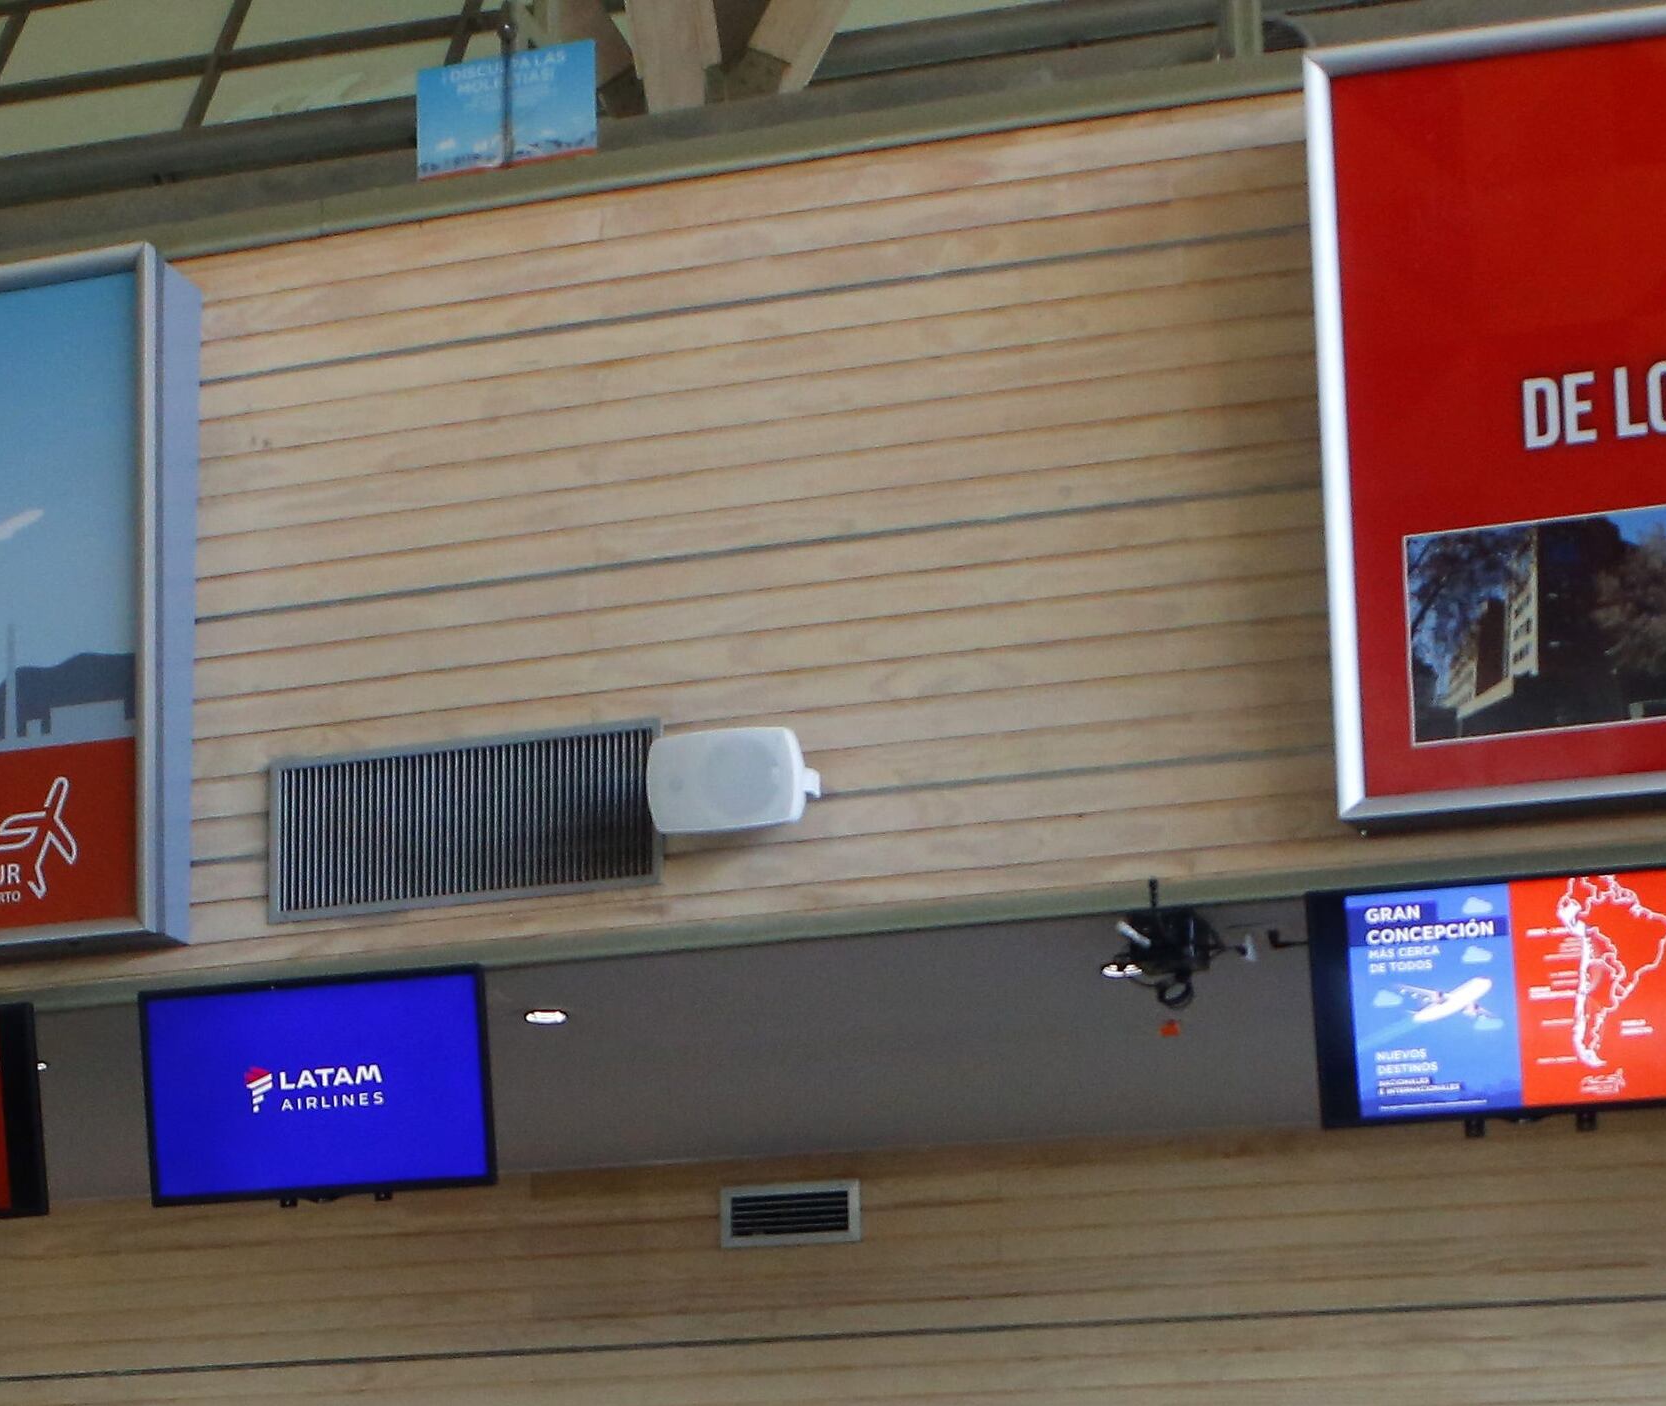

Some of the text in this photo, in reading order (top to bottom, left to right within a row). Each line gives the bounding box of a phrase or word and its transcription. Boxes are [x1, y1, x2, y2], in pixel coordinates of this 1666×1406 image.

[1522, 371, 1596, 449] DE
[1365, 904, 1421, 924] GRAN
[1365, 918, 1495, 945] CONCEPCIÓN
[1399, 944, 1440, 957] CERCA
[1369, 959, 1433, 974] DE TODOS
[279, 1064, 383, 1090] LATAM
[281, 1091, 385, 1111] AIRLINES
